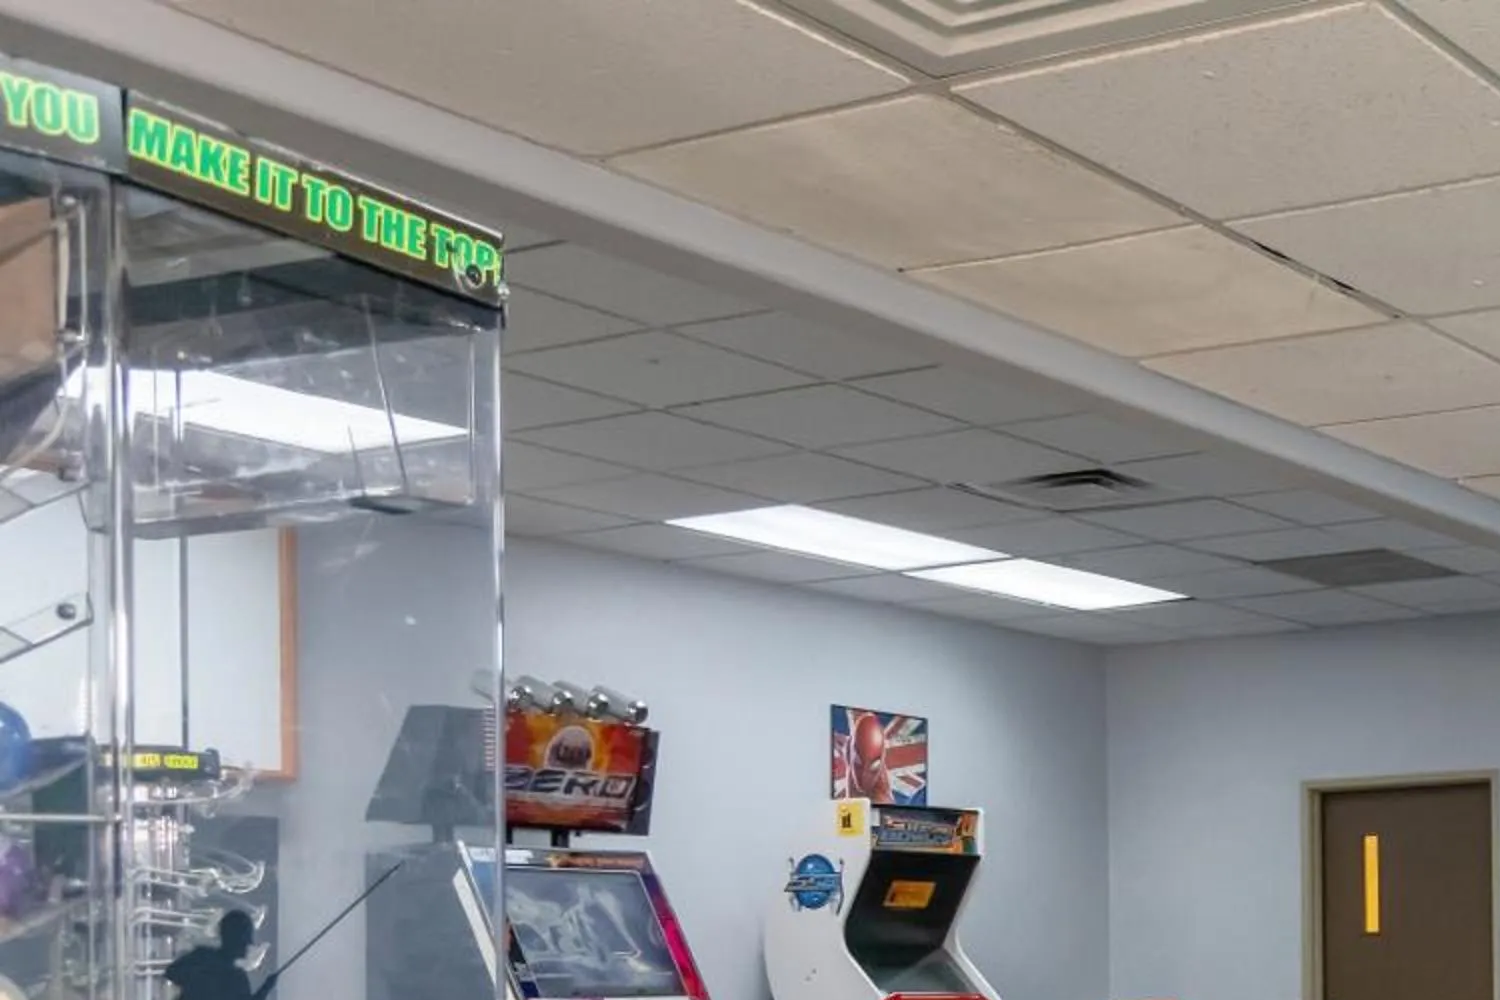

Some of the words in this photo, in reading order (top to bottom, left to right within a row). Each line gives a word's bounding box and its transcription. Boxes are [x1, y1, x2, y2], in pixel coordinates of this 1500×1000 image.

[0, 70, 100, 144] YOU
[128, 108, 250, 198] MAKE
[256, 155, 297, 212] IT
[302, 174, 353, 232] TO
[358, 195, 428, 260] THE
